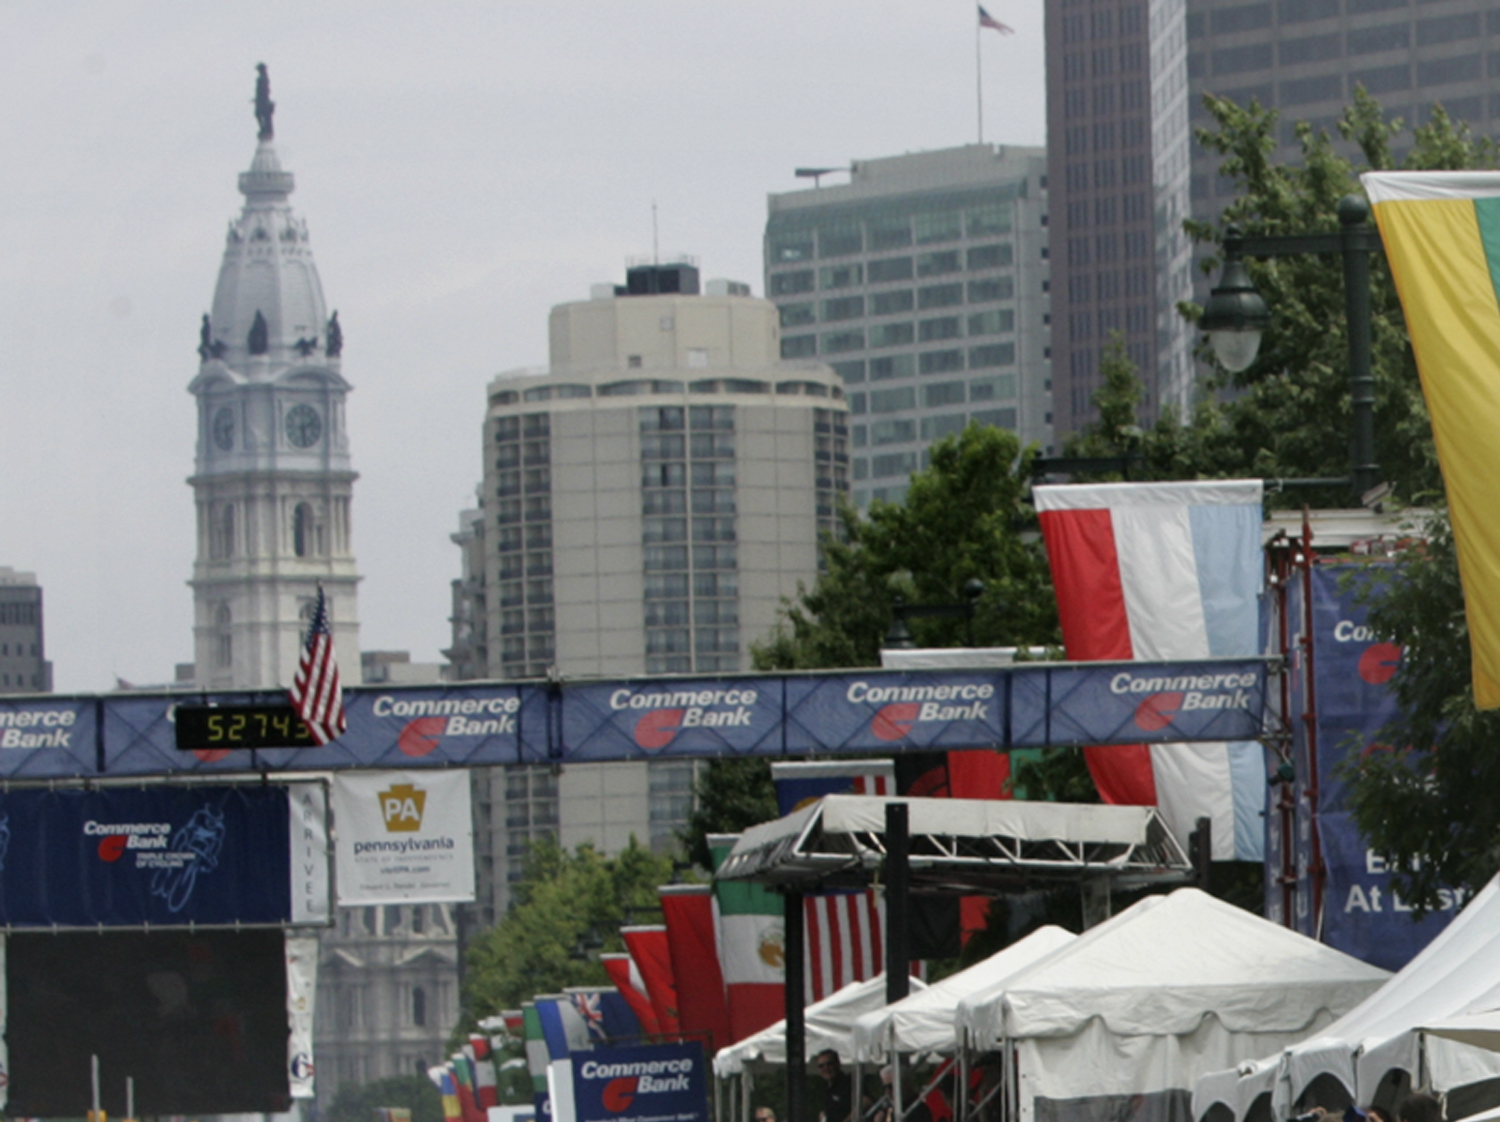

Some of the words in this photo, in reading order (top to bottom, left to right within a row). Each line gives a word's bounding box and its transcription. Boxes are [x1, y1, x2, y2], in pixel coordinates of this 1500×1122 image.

[847, 681, 994, 702] Commerce
[1110, 672, 1256, 693] Commerce
[373, 696, 520, 717] Commerce
[609, 689, 757, 710] Commerce
[1181, 690, 1250, 710] Bank
[682, 708, 751, 728] Bank
[919, 701, 988, 721] Bank
[445, 716, 515, 736] Bank
[2, 729, 72, 748] Bank
[384, 797, 420, 822] PA
[84, 821, 171, 836] Commerce
[127, 835, 168, 849] Bank
[354, 837, 455, 855] pennsylvania
[1344, 884, 1383, 913] At
[581, 1059, 694, 1079] Commerce
[637, 1074, 691, 1094] Bank
